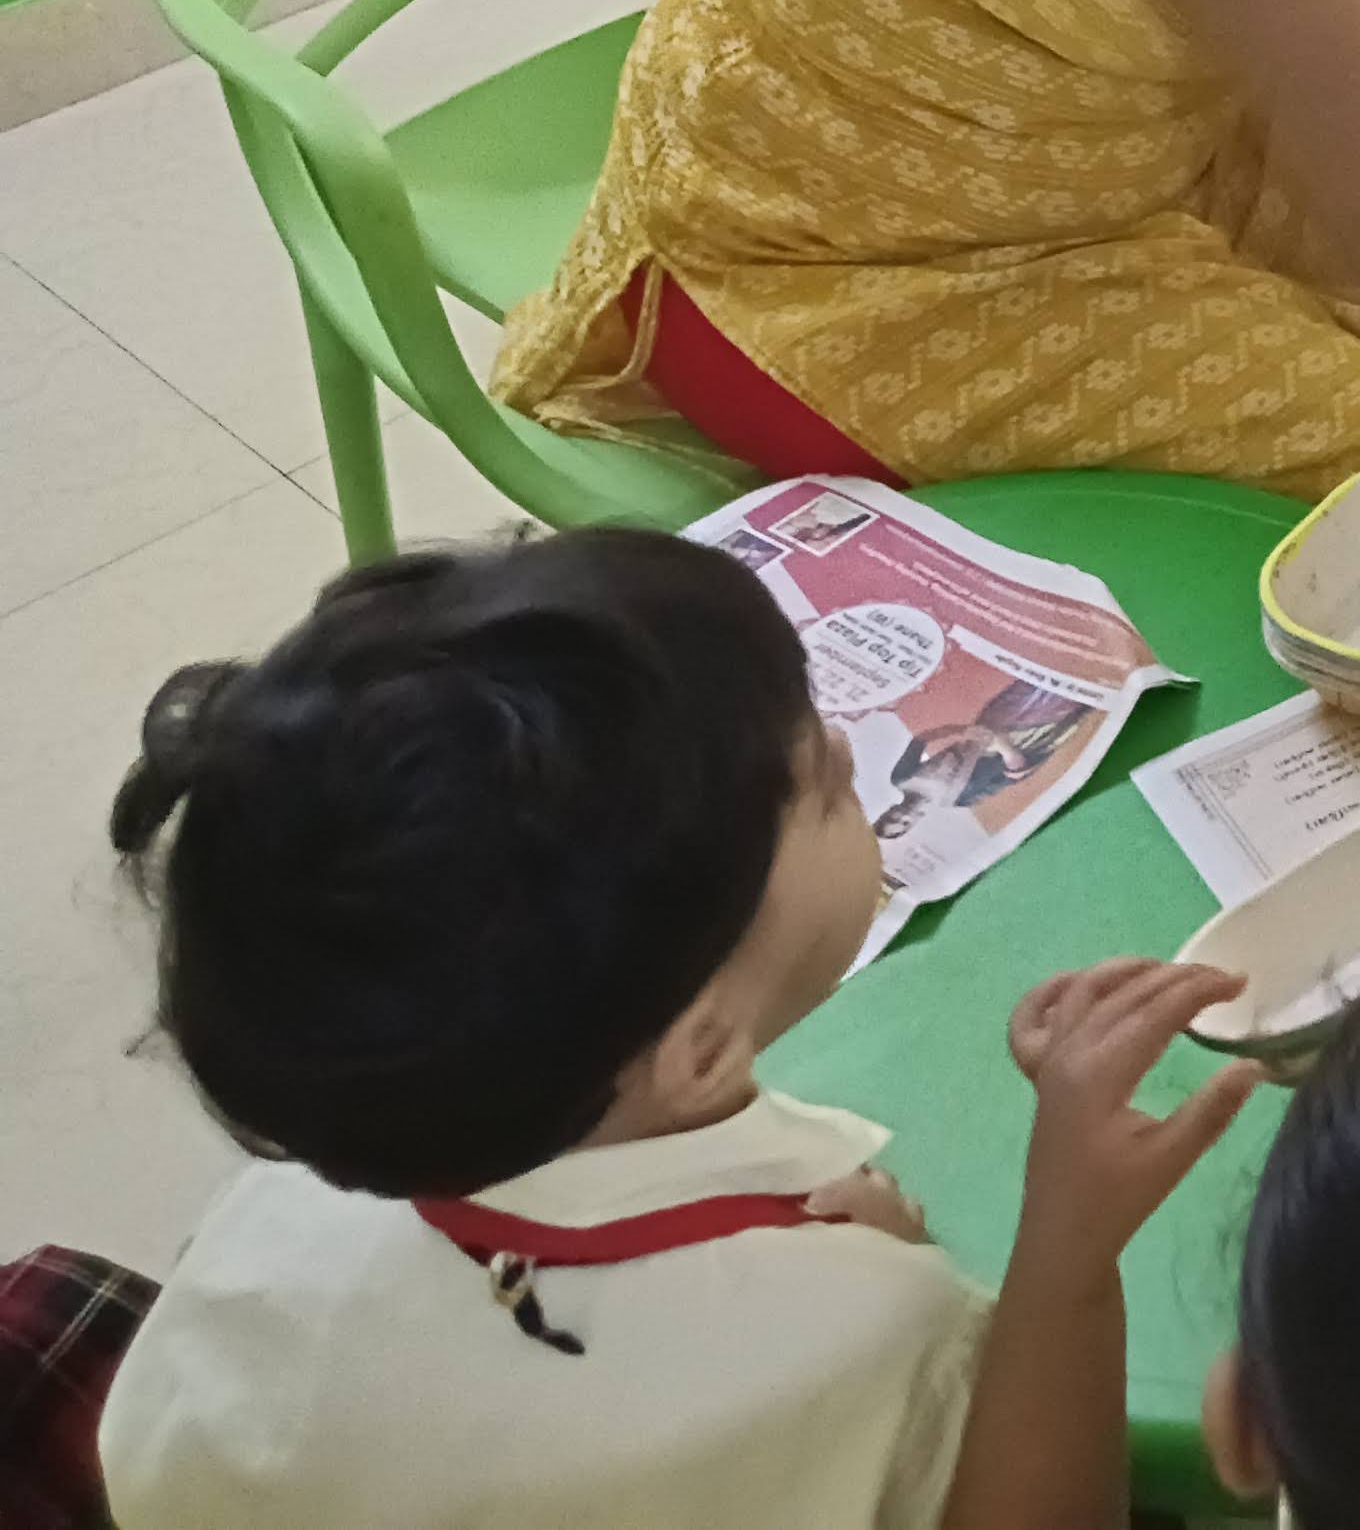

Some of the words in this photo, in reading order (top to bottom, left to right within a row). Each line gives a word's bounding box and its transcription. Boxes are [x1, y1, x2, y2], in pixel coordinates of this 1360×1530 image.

[827, 620, 867, 647] Plaza
[895, 624, 932, 650] Thane
[868, 643, 895, 664] Top
[897, 659, 922, 678] Tip
